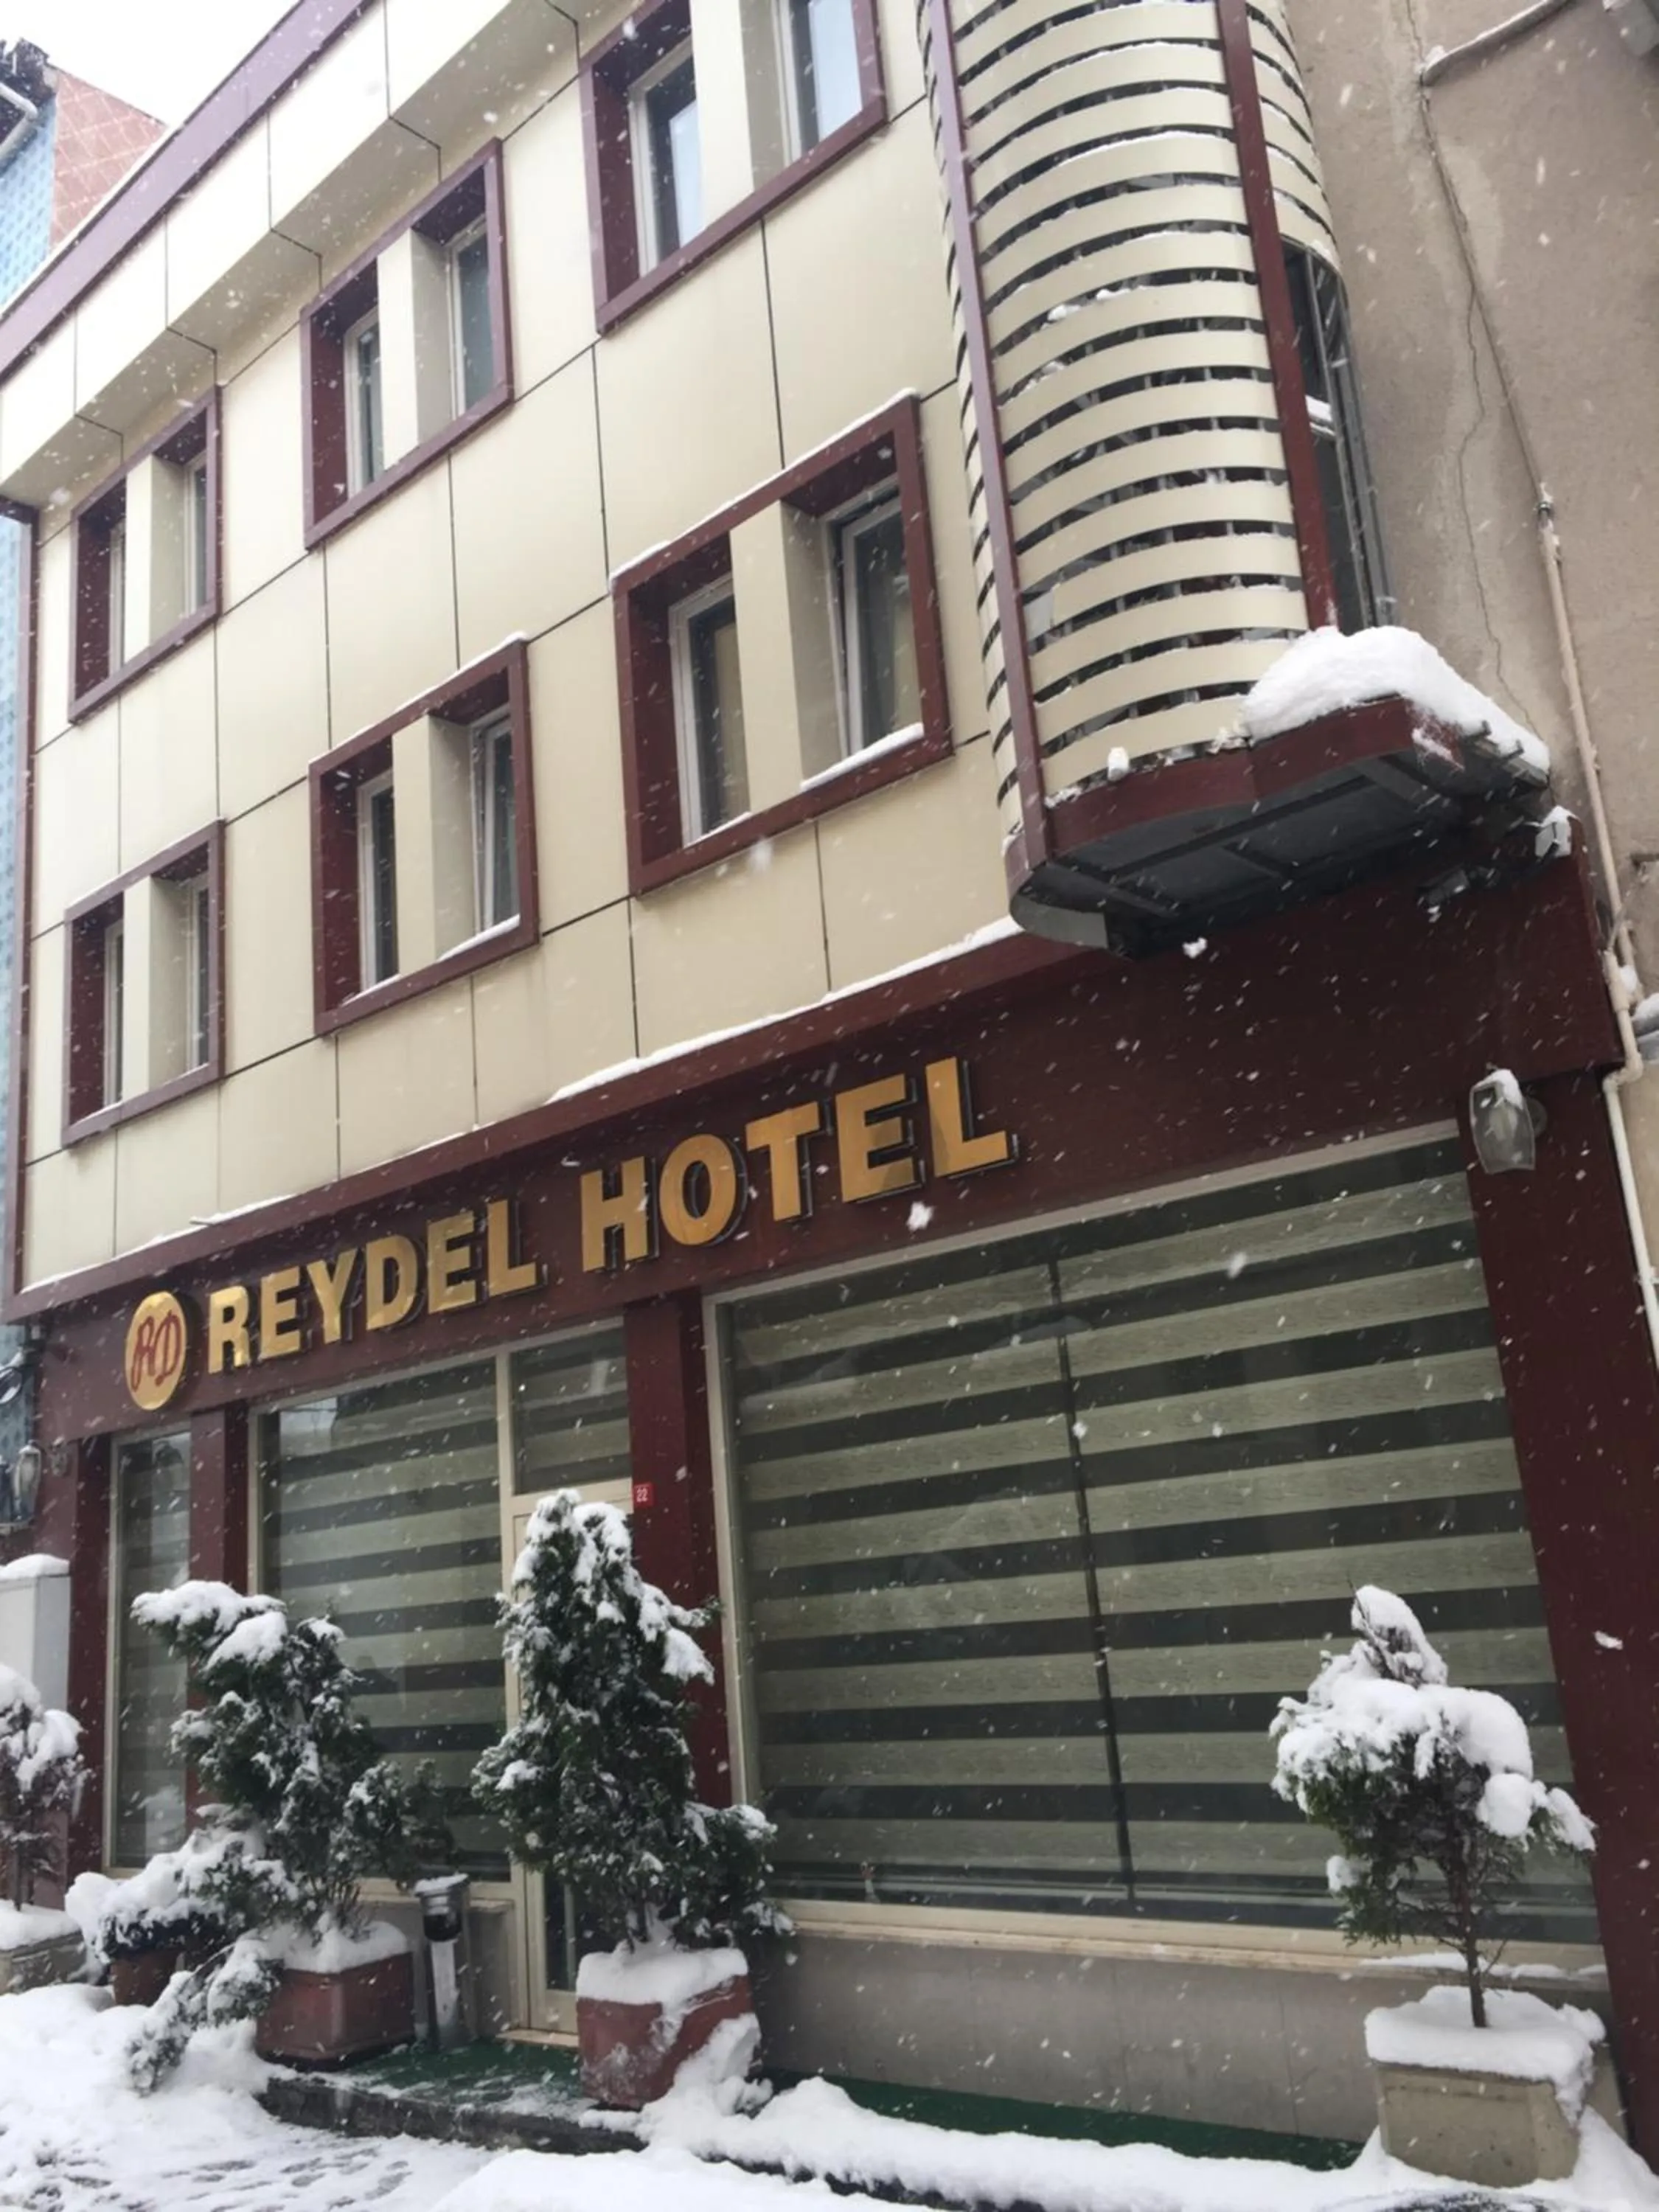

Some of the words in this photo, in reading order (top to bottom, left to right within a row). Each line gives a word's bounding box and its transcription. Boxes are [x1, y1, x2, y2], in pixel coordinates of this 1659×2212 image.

[208, 1200, 537, 1374] REYDEL
[580, 1057, 1009, 1273] HOTEL
[636, 1488, 649, 1503] 22
